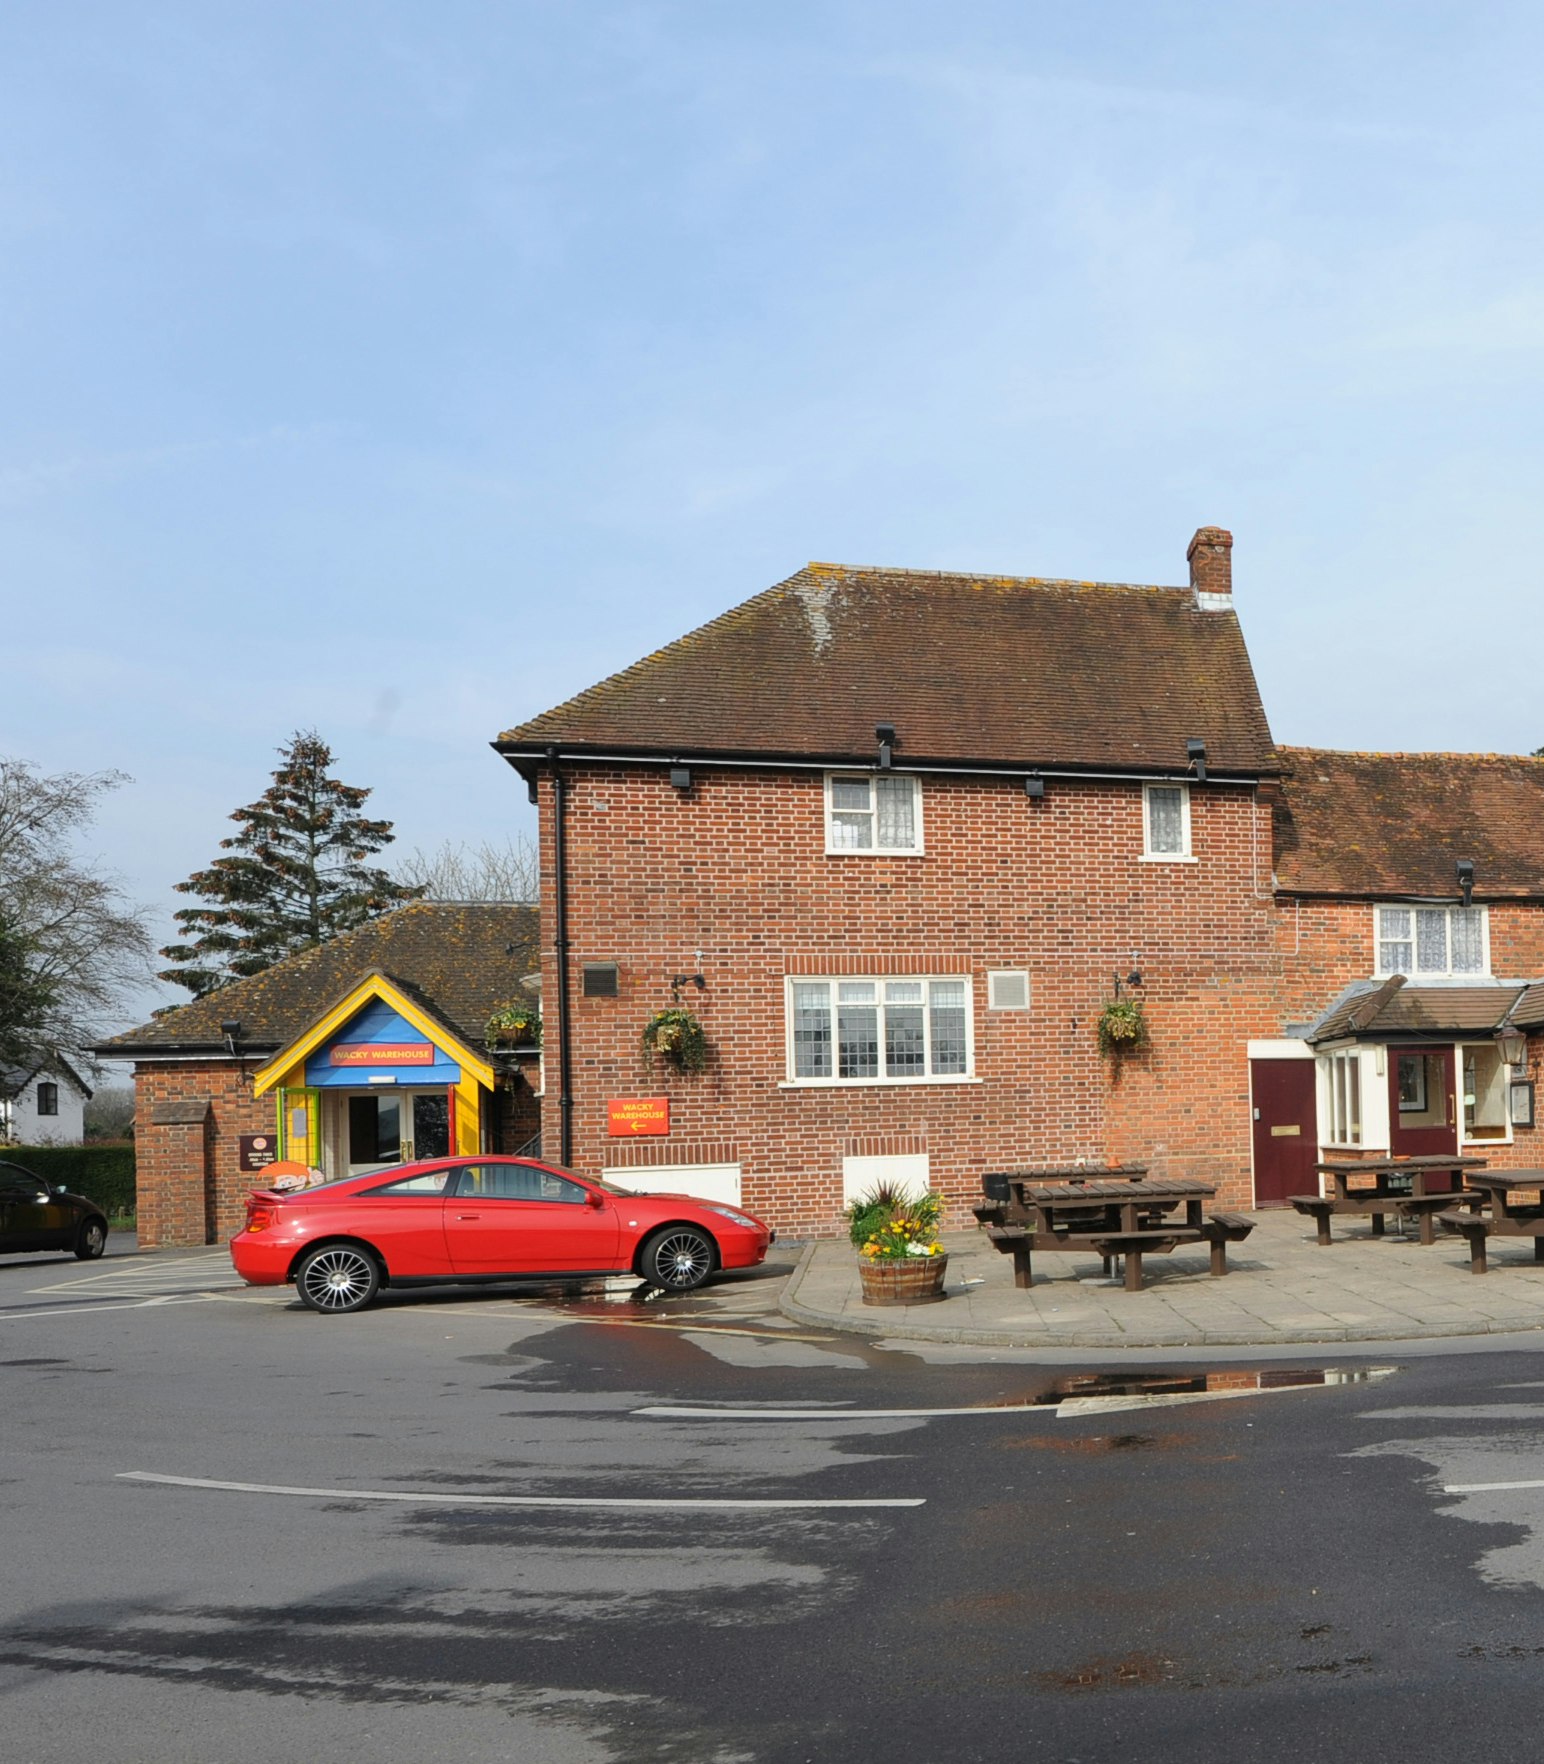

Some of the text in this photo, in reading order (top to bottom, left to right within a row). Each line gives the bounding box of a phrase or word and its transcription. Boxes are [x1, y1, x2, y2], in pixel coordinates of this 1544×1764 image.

[334, 1050, 429, 1059] WACKY WAREHOUSE
[623, 1103, 653, 1111] WACKY
[611, 1111, 665, 1120] WAREHOUSE
